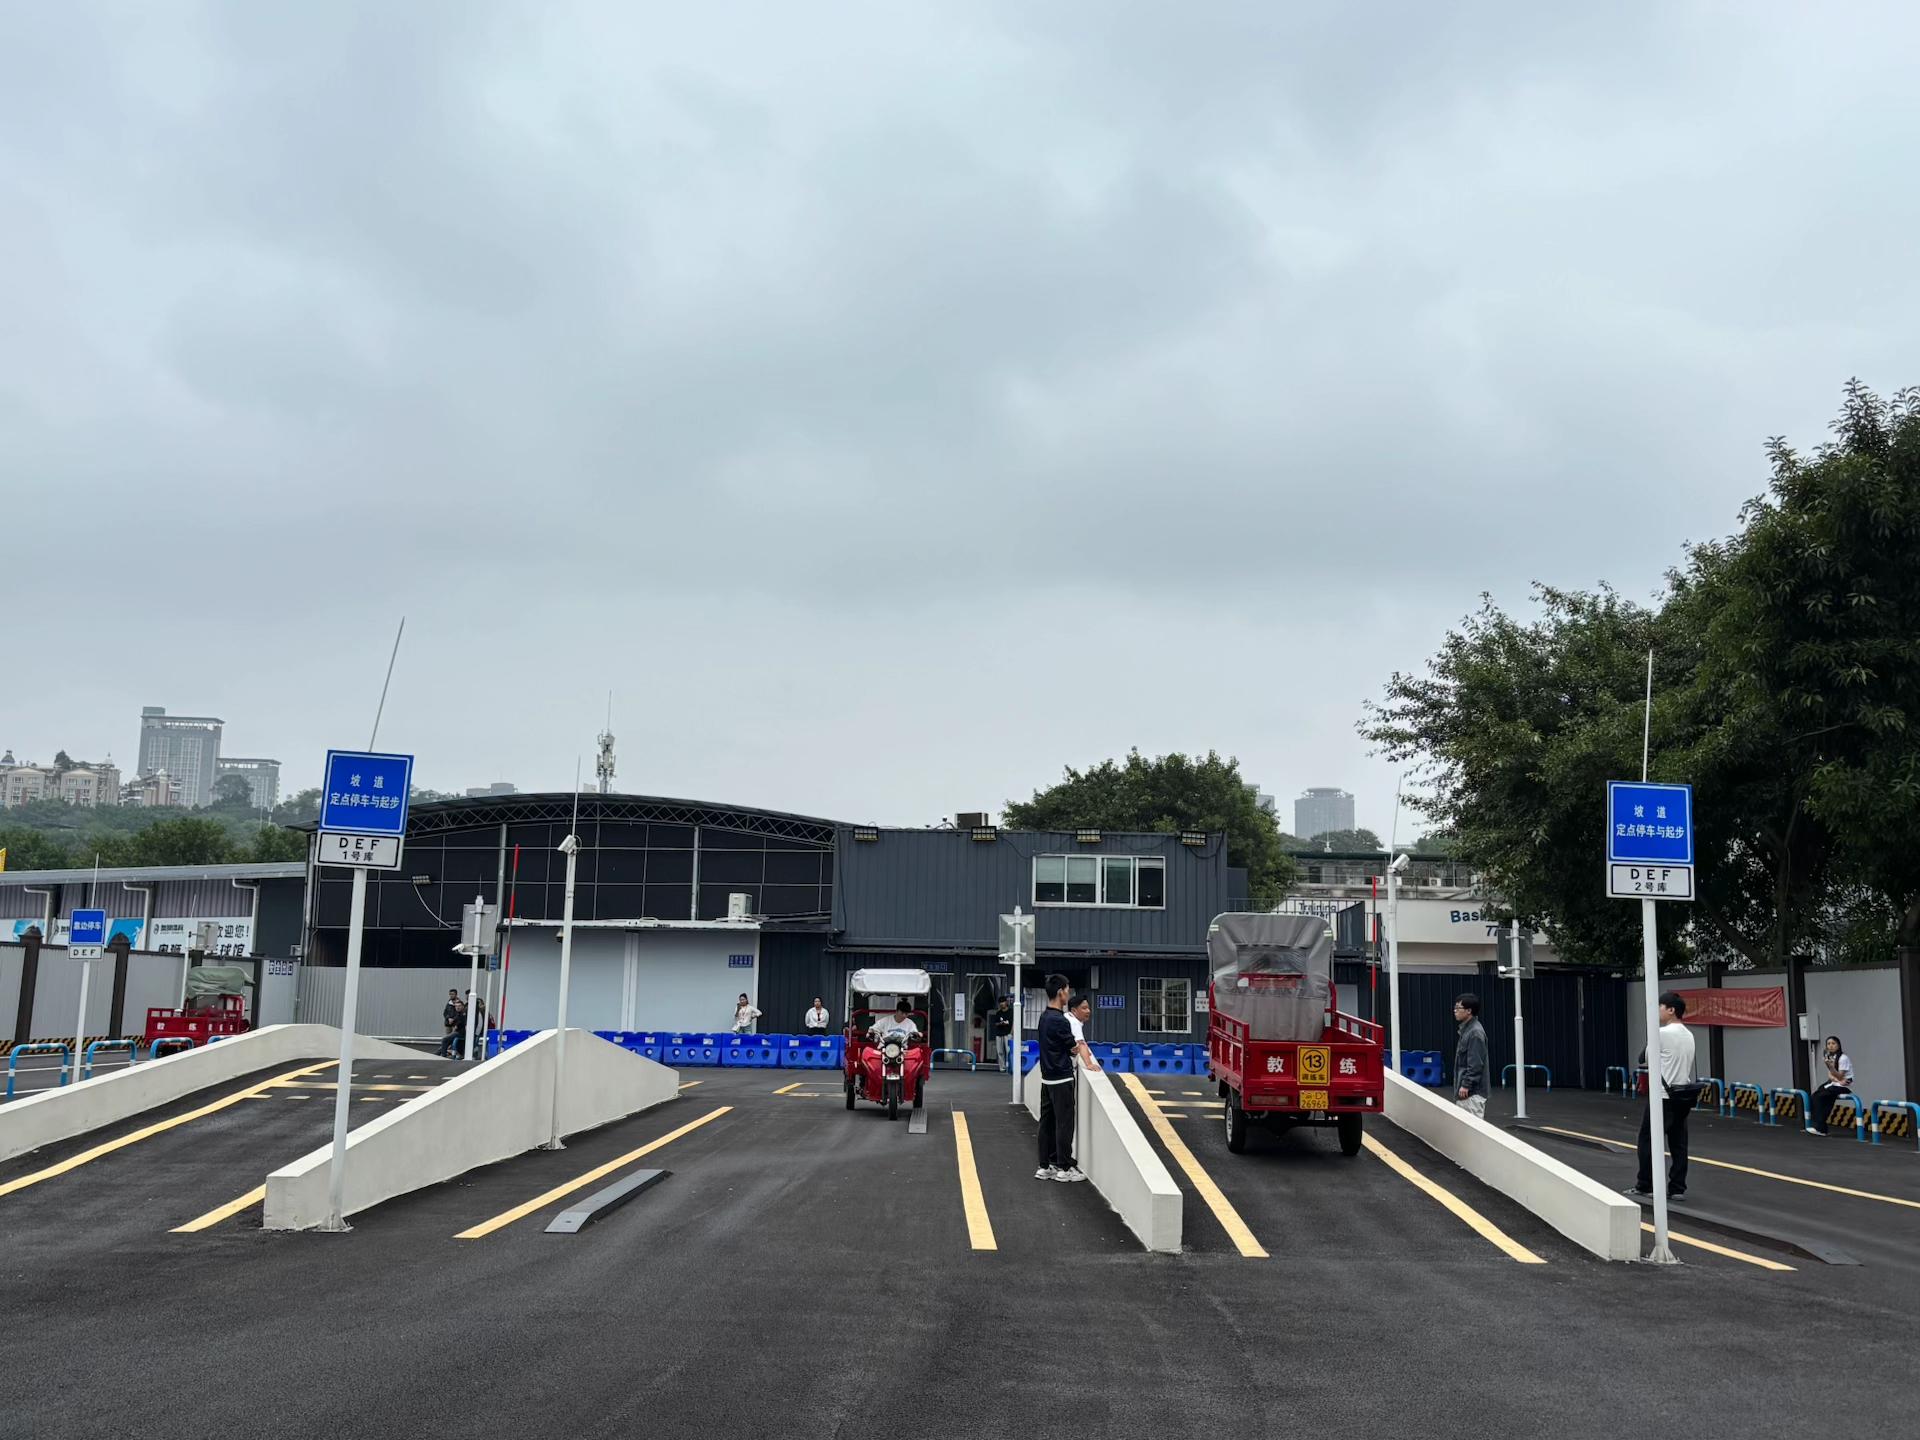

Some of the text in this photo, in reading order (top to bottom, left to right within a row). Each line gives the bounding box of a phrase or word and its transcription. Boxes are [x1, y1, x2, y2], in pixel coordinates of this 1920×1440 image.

[349, 774, 384, 789] 坡道
[329, 792, 400, 809] 定点停车与起步
[1633, 805, 1667, 819] 坡道
[1616, 824, 1685, 839] 定点停车与起步
[342, 851, 374, 862] 1号库
[1634, 882, 1667, 893] 2号库
[1305, 1054, 1323, 1069] 13
[1301, 1073, 1326, 1081] 训练车
